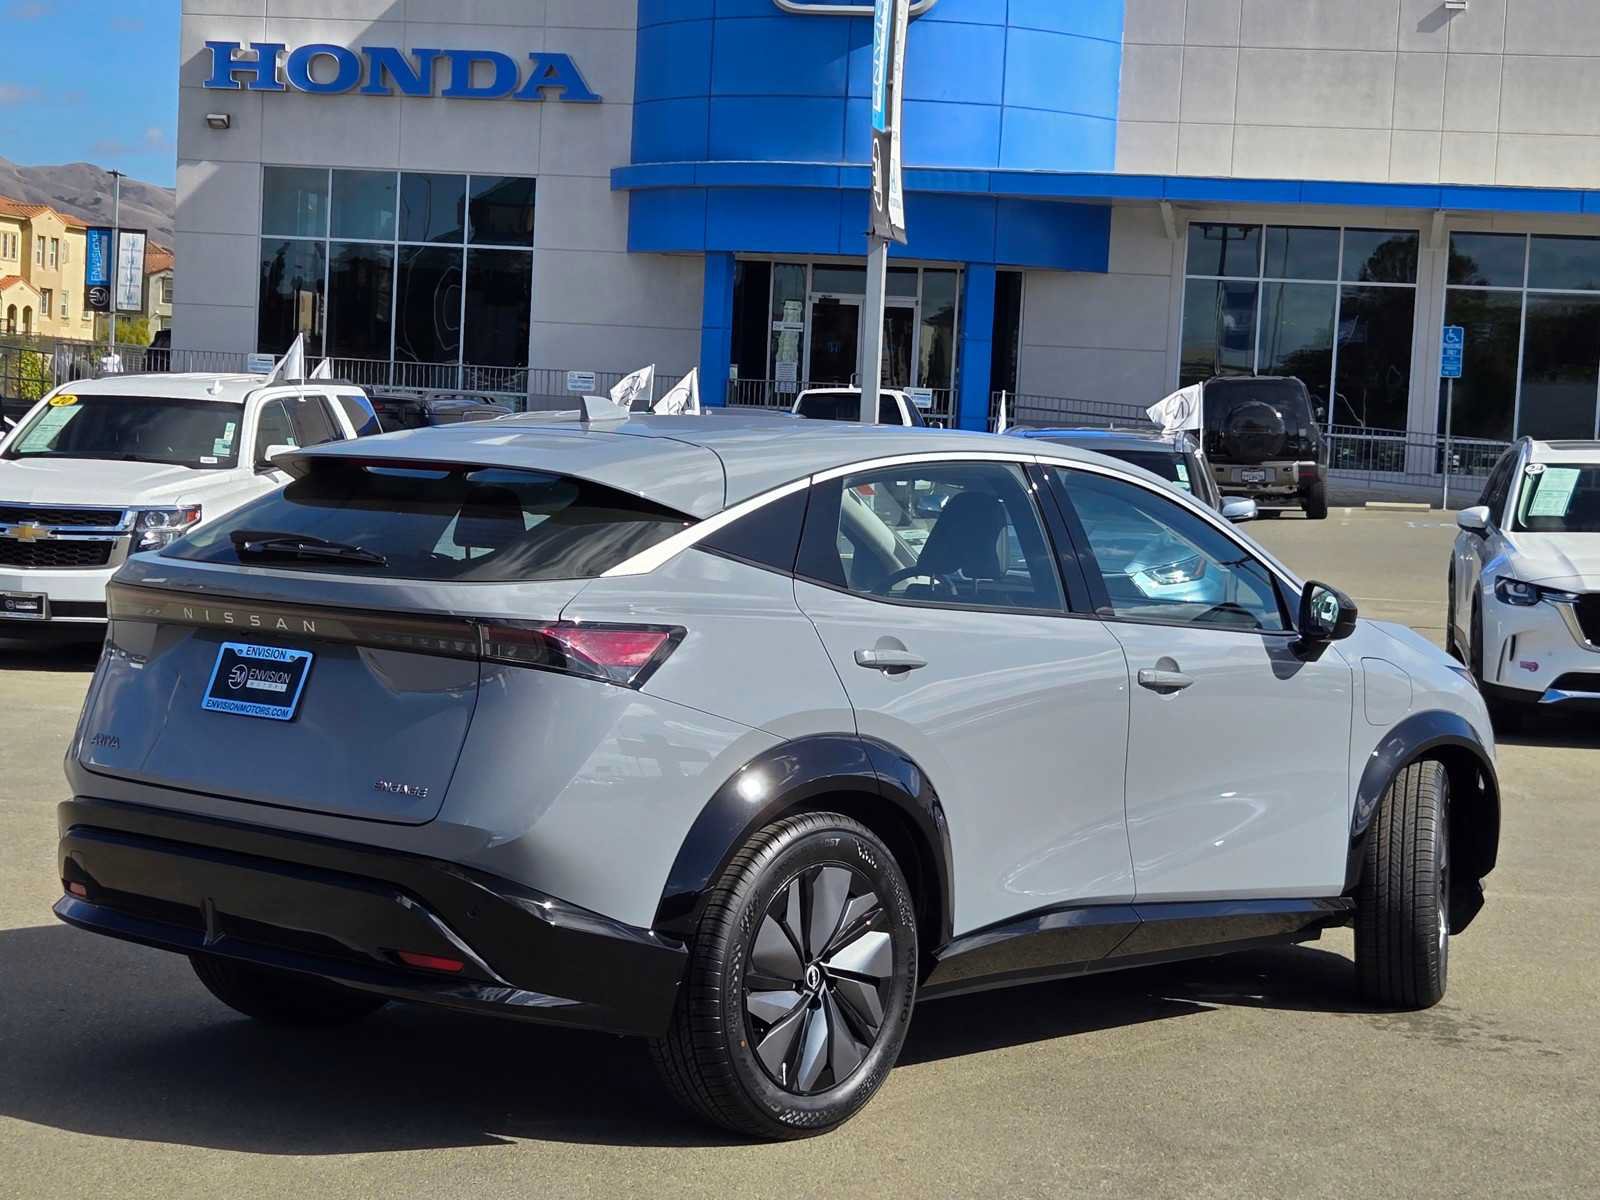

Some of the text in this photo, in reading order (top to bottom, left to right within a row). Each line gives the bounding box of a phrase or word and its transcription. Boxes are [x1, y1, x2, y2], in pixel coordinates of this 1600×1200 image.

[202, 40, 602, 103] HONDA
[183, 607, 316, 633] NISSAN
[246, 646, 287, 660] ENVISION
[249, 669, 291, 684] ENVISION
[206, 699, 290, 718] ENVISIONMOTORS.COM
